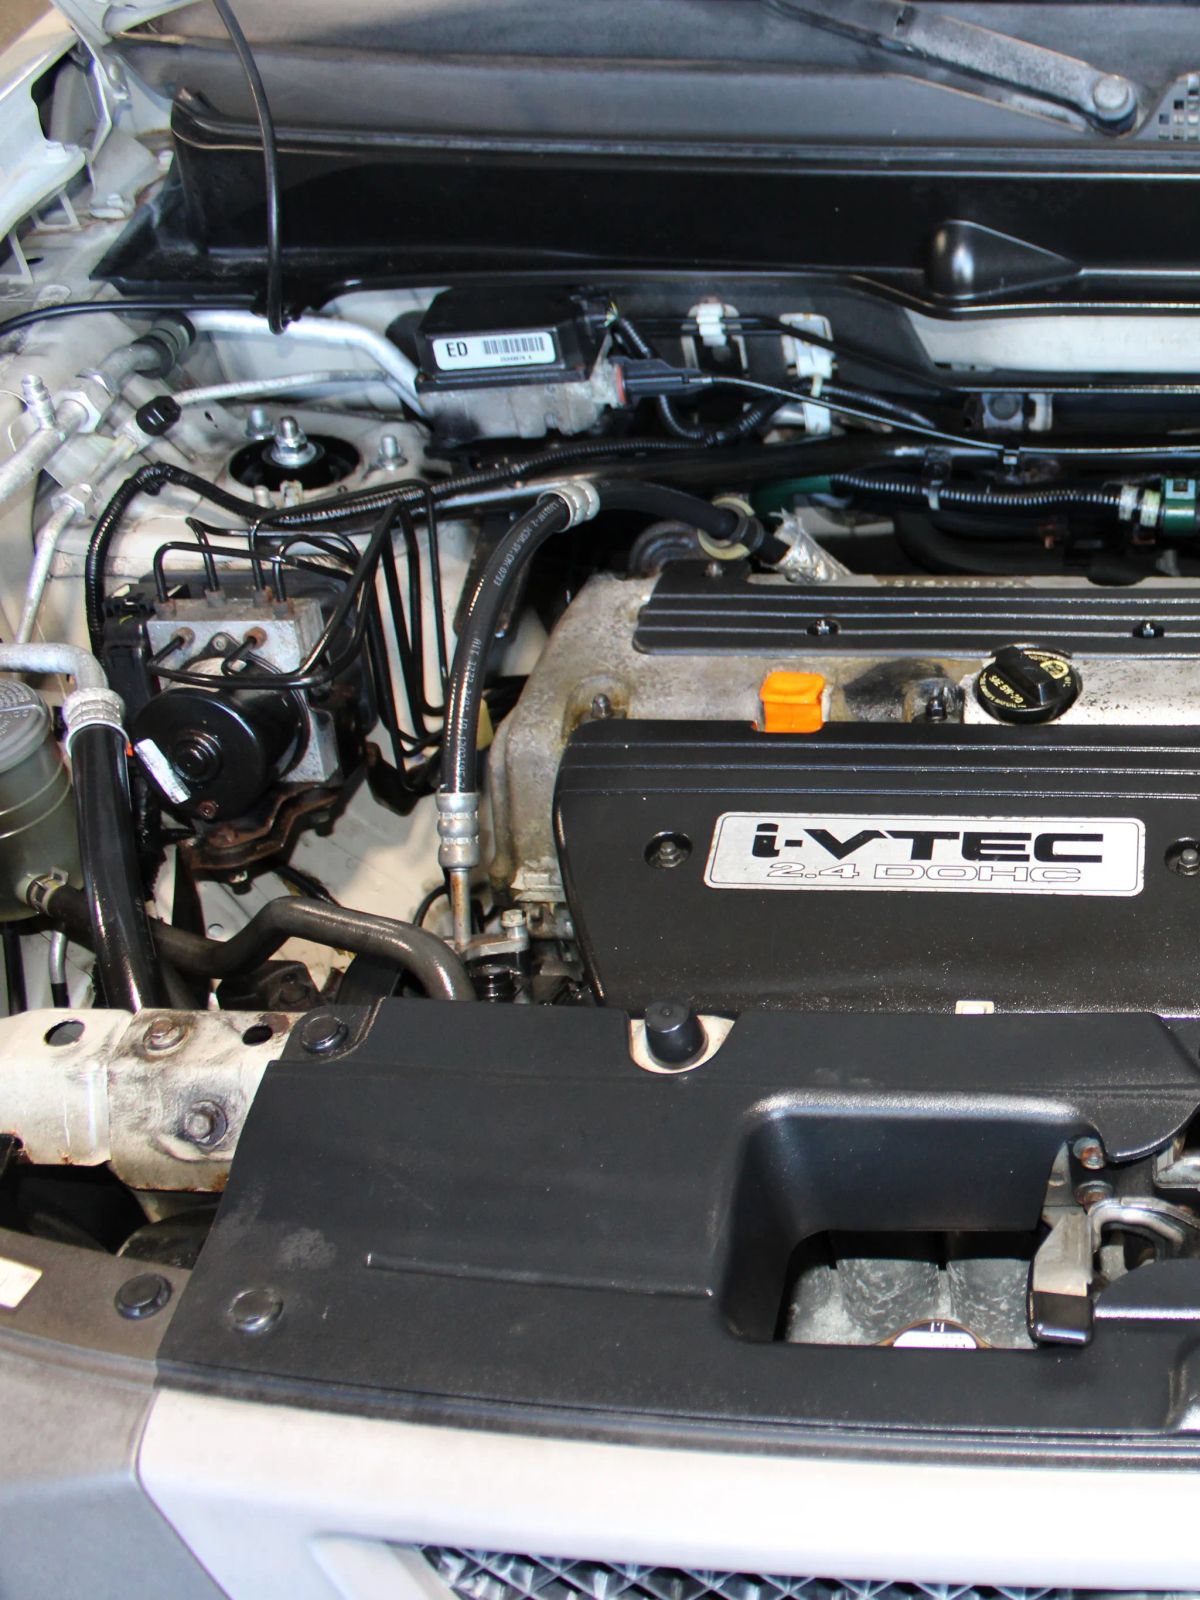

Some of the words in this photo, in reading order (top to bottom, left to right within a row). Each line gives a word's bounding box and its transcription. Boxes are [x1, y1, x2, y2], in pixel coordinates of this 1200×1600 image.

[446, 341, 469, 358] ED
[751, 822, 1104, 864] i-VTEC
[766, 861, 860, 879] 2.4
[873, 863, 1082, 883] DOHC
